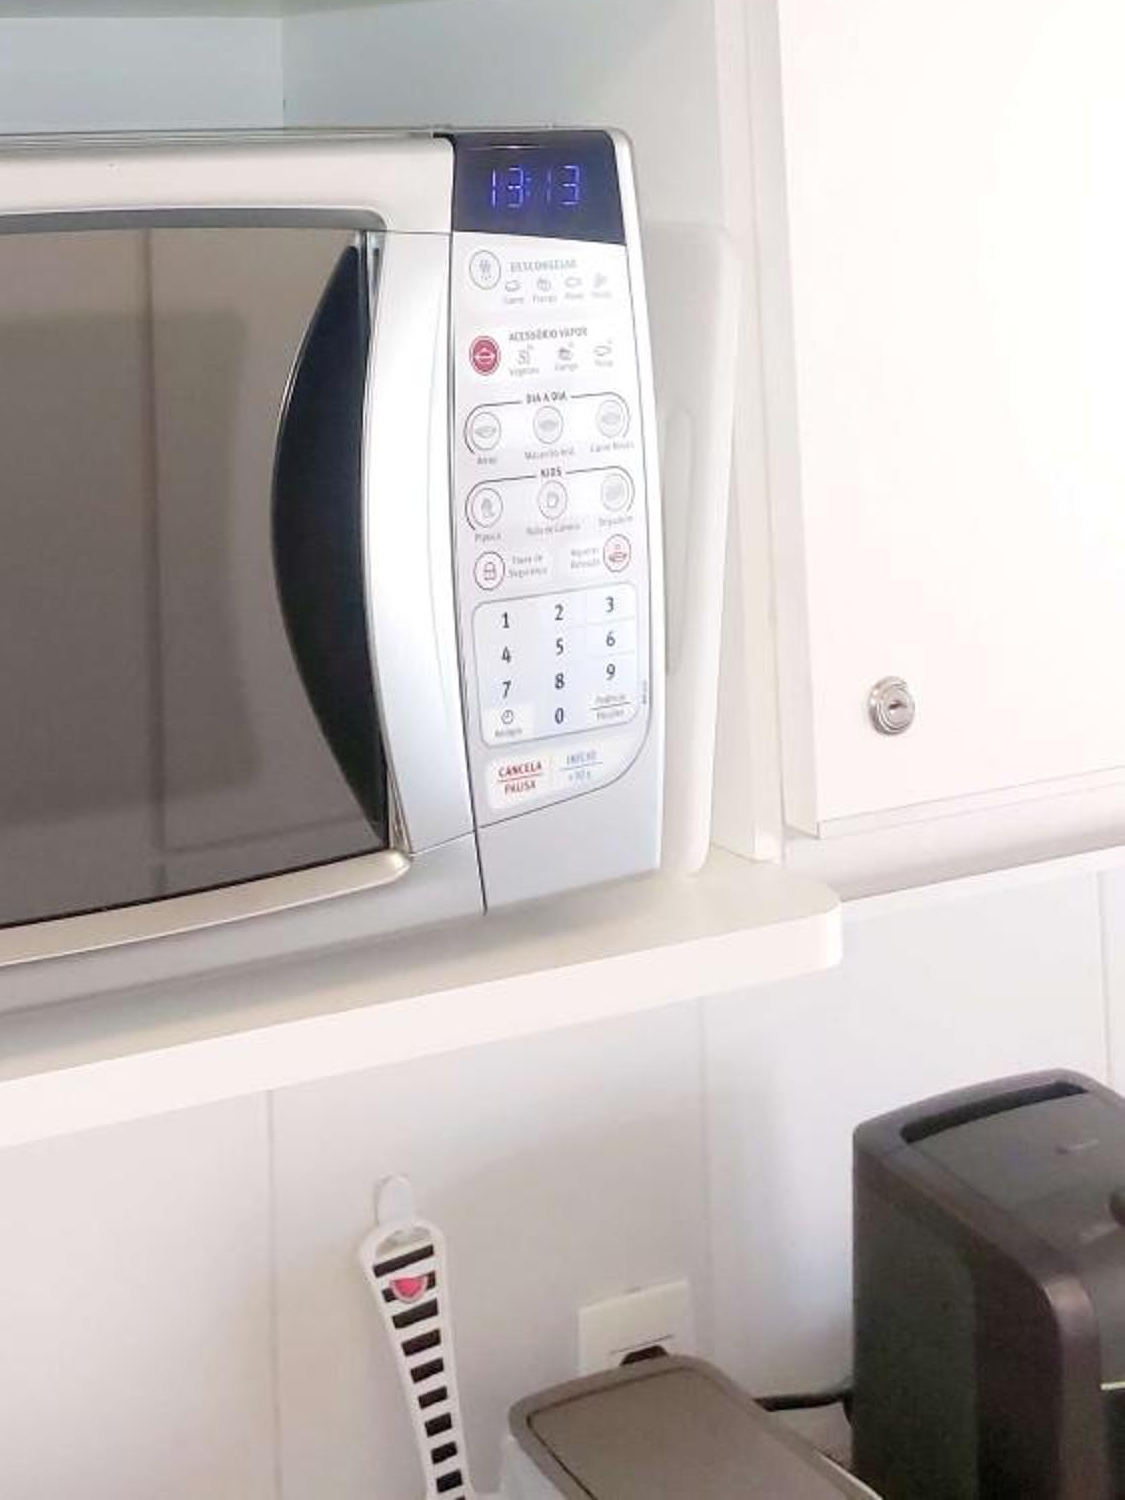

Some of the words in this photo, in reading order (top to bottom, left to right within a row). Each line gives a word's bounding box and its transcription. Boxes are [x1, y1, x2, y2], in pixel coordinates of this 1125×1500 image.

[502, 612, 510, 628] 1
[555, 604, 564, 621] 2
[605, 596, 615, 613] 3
[501, 647, 511, 663] 4
[556, 637, 564, 656] 5
[606, 631, 616, 647] 6
[502, 680, 511, 699] 7
[555, 673, 565, 690] 8
[606, 663, 616, 681] 9
[554, 707, 564, 724] 0
[498, 760, 542, 778] CANCELA
[504, 780, 537, 795] PAUSA
